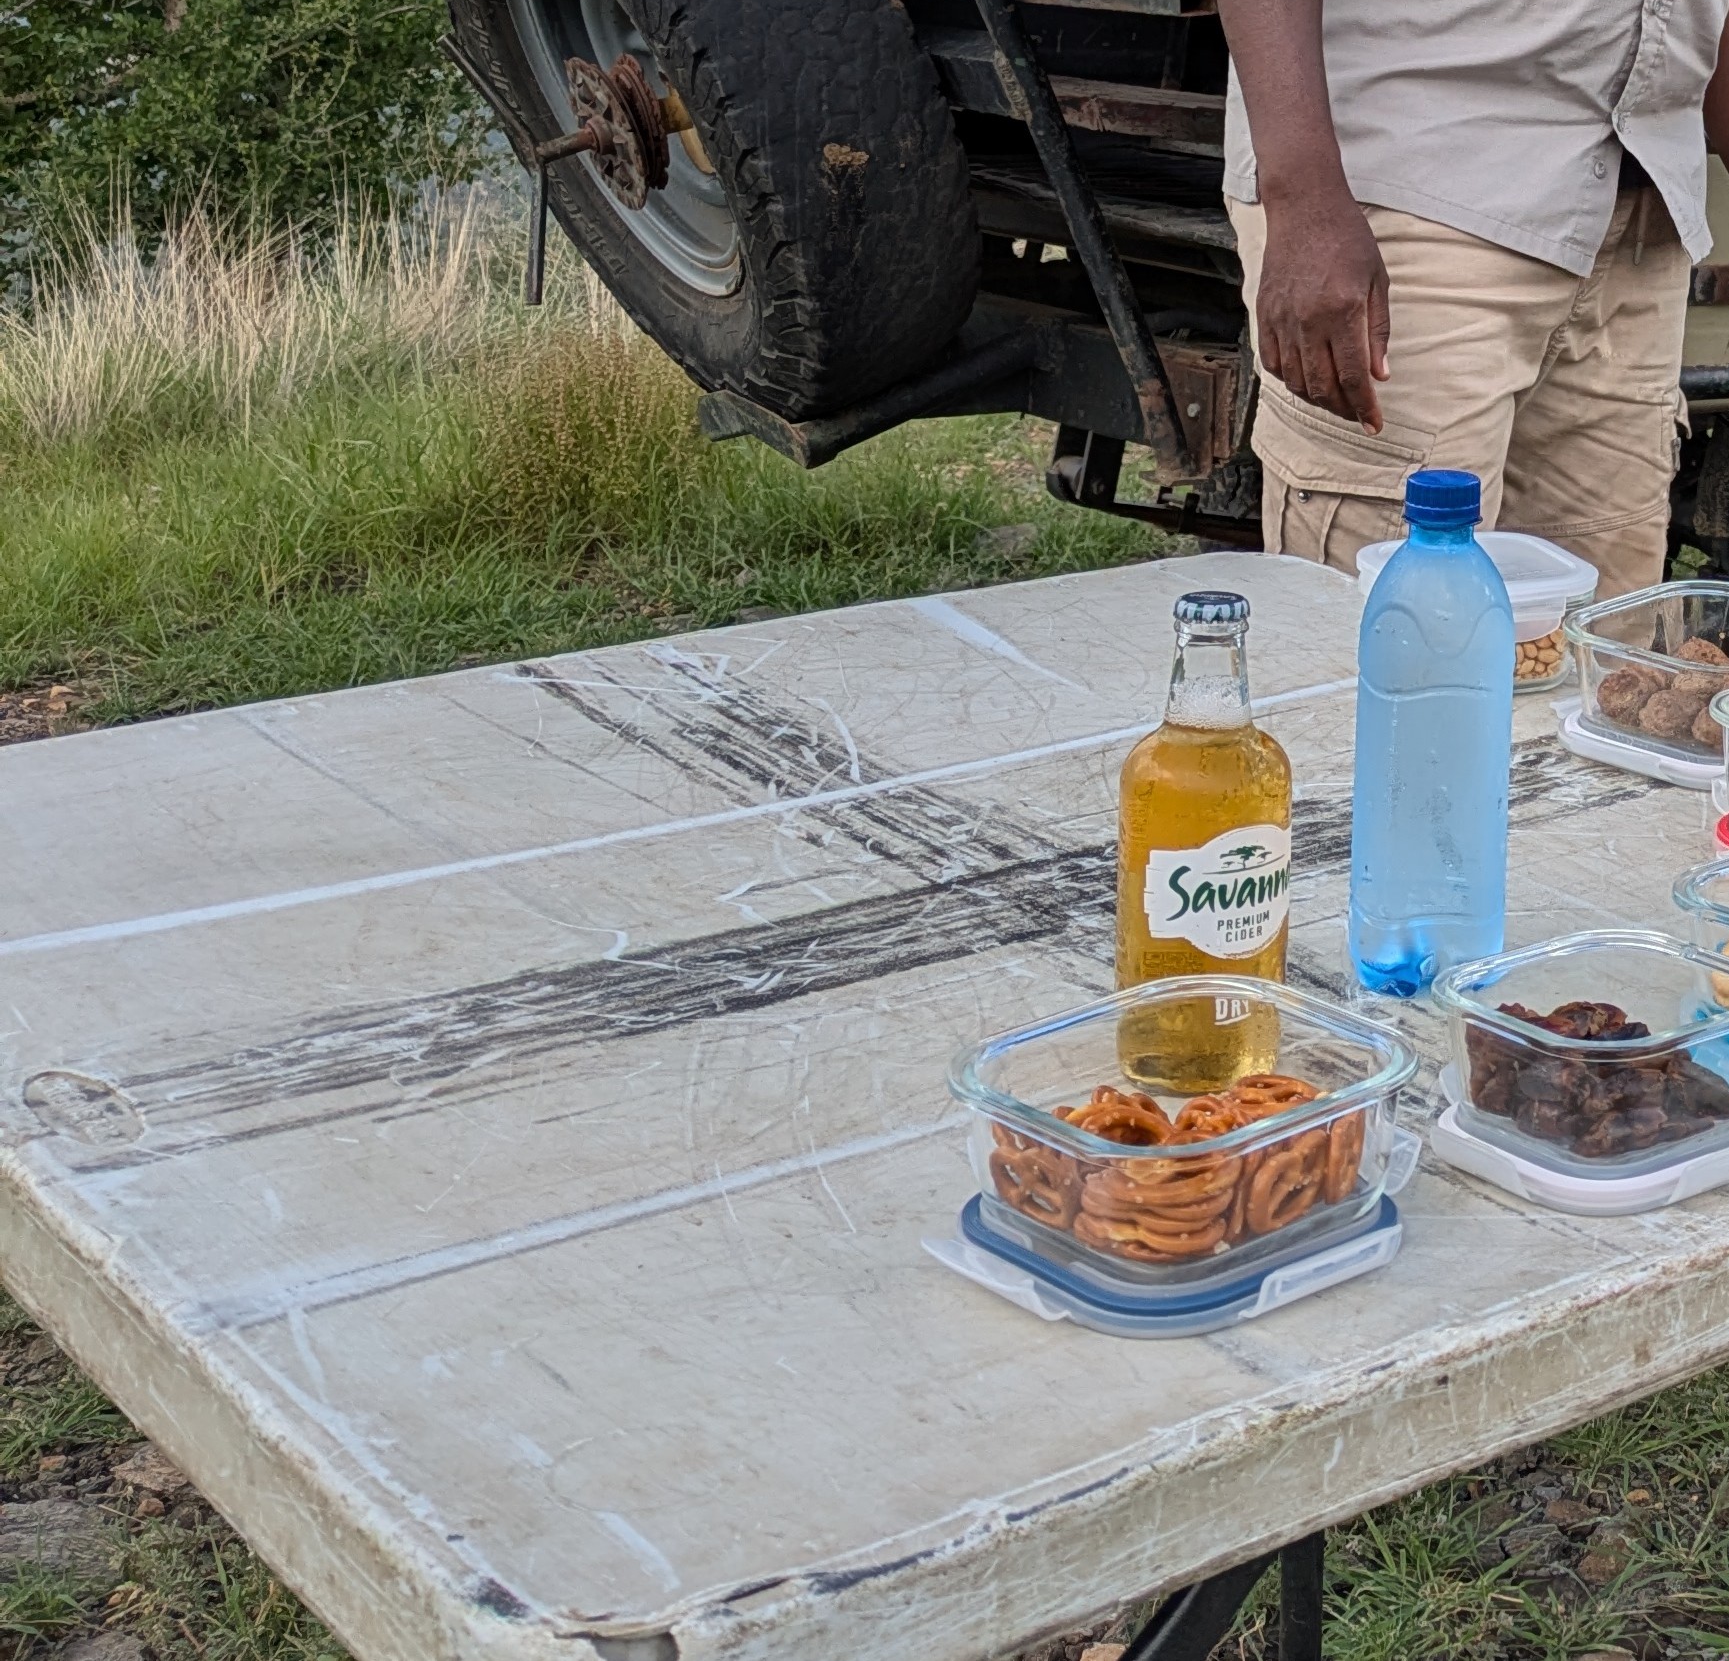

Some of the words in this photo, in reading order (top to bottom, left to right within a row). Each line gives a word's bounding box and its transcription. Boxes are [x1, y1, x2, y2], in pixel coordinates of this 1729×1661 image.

[1216, 909, 1271, 932] PREMIUM
[1224, 924, 1264, 943] CIDER
[1214, 997, 1250, 1022] DRY
